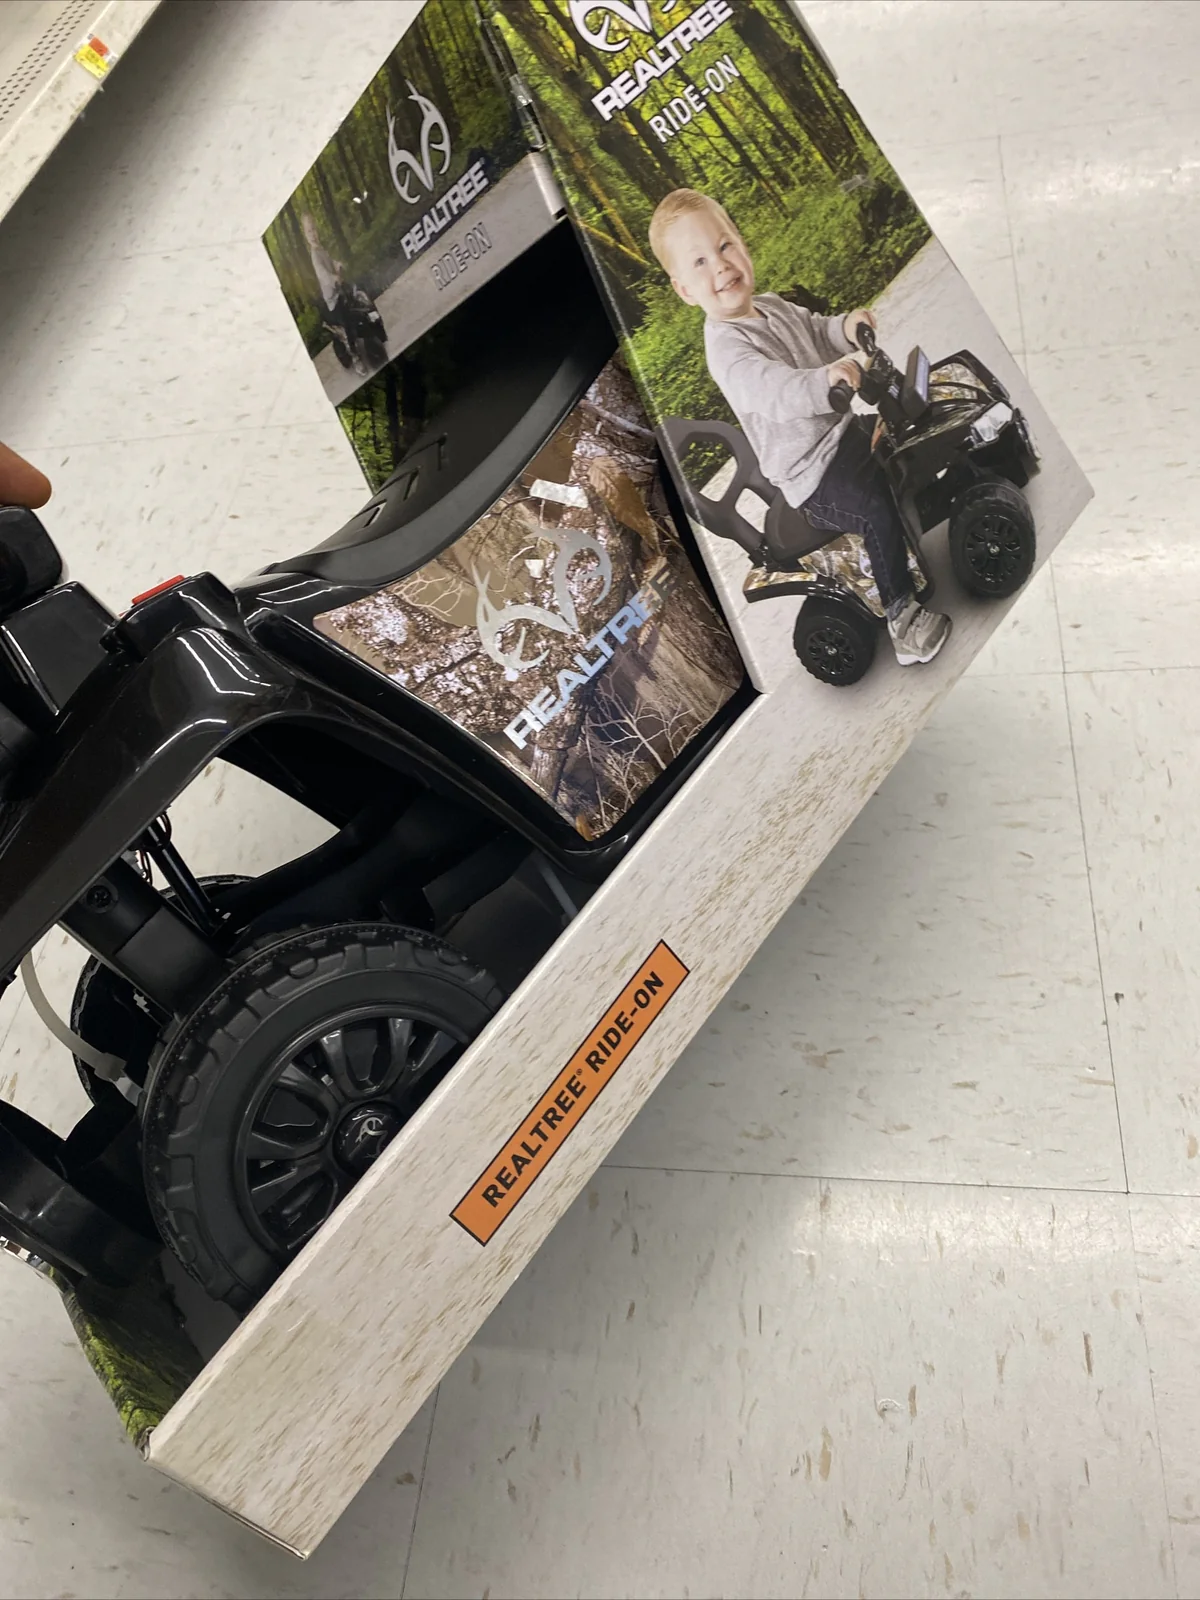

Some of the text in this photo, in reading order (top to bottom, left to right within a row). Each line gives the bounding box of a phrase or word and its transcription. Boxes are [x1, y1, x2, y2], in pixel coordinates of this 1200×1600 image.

[591, 0, 734, 121] REALTREE
[648, 54, 740, 143] RIDE-ON
[430, 221, 493, 291] RIDE-ON
[584, 971, 664, 1073] RIDE-ON
